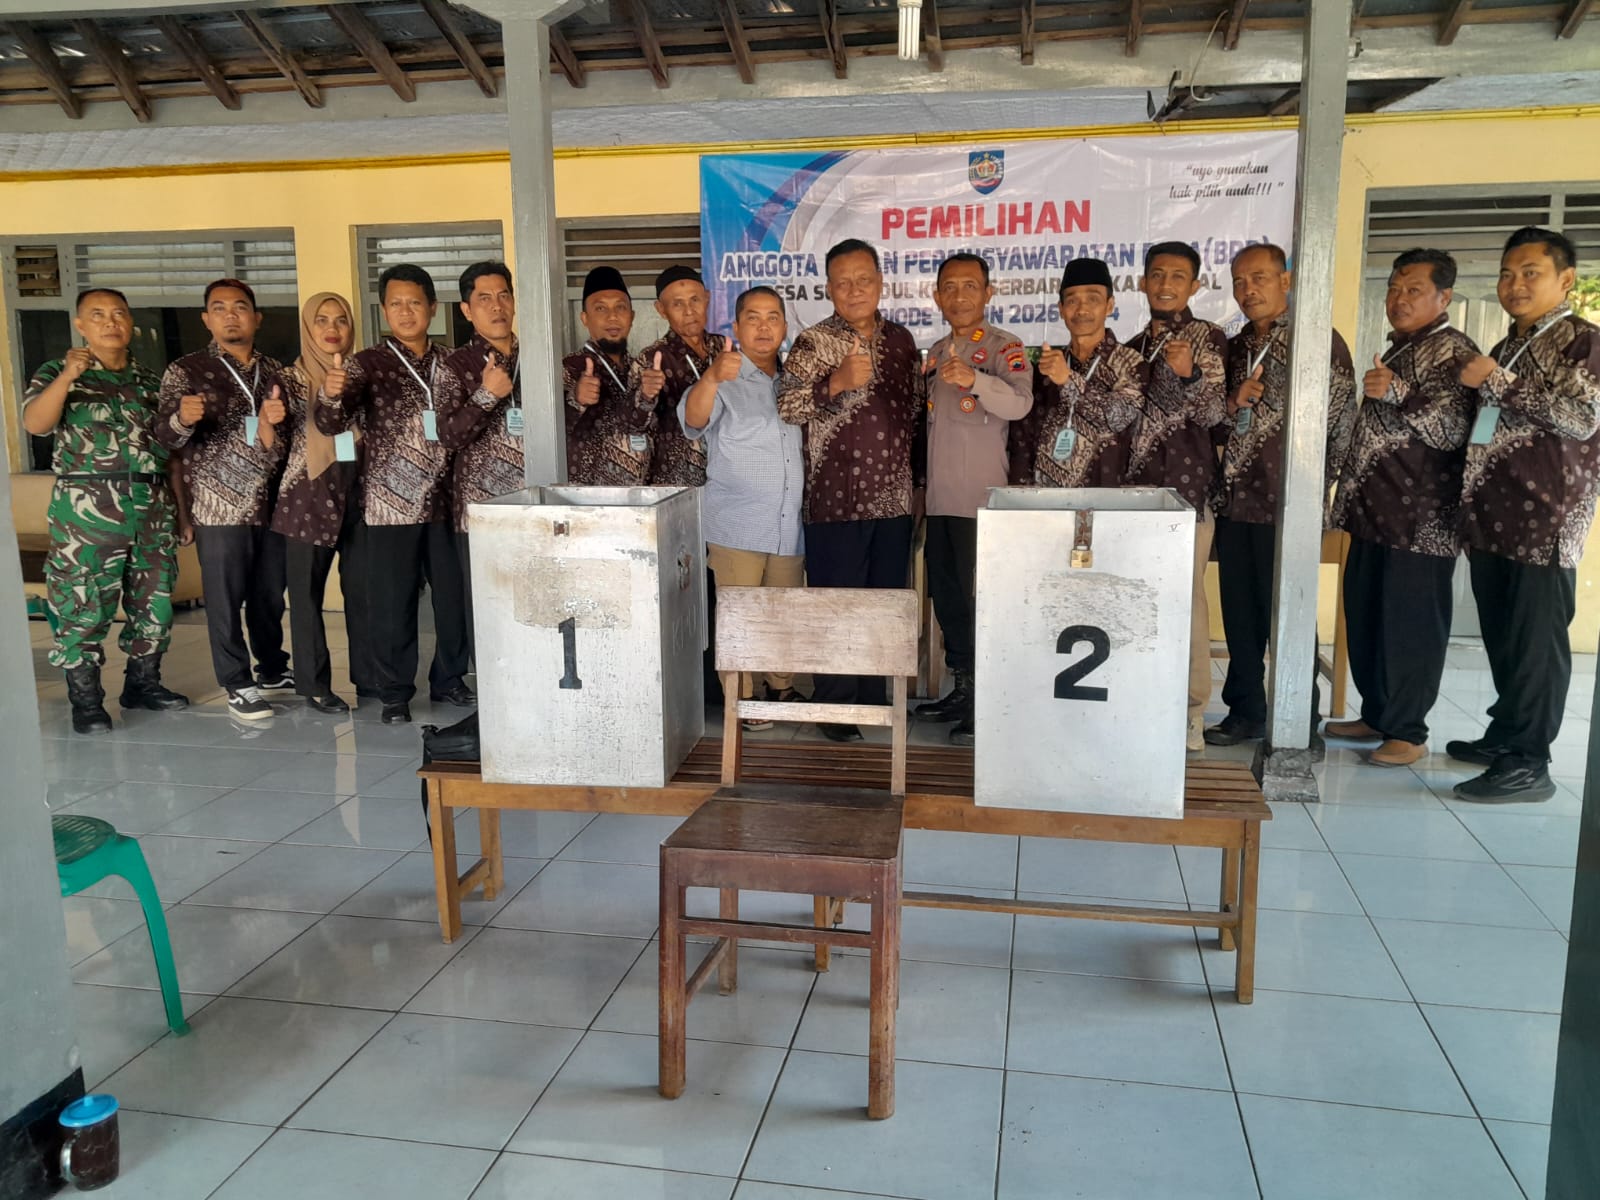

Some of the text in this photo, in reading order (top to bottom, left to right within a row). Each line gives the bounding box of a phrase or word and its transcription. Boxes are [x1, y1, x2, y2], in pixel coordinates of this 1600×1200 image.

[881, 200, 1091, 240] PEMILIHAN
[721, 252, 820, 279] ANGGOTA
[558, 617, 583, 690] 1
[1053, 624, 1111, 702] 2
